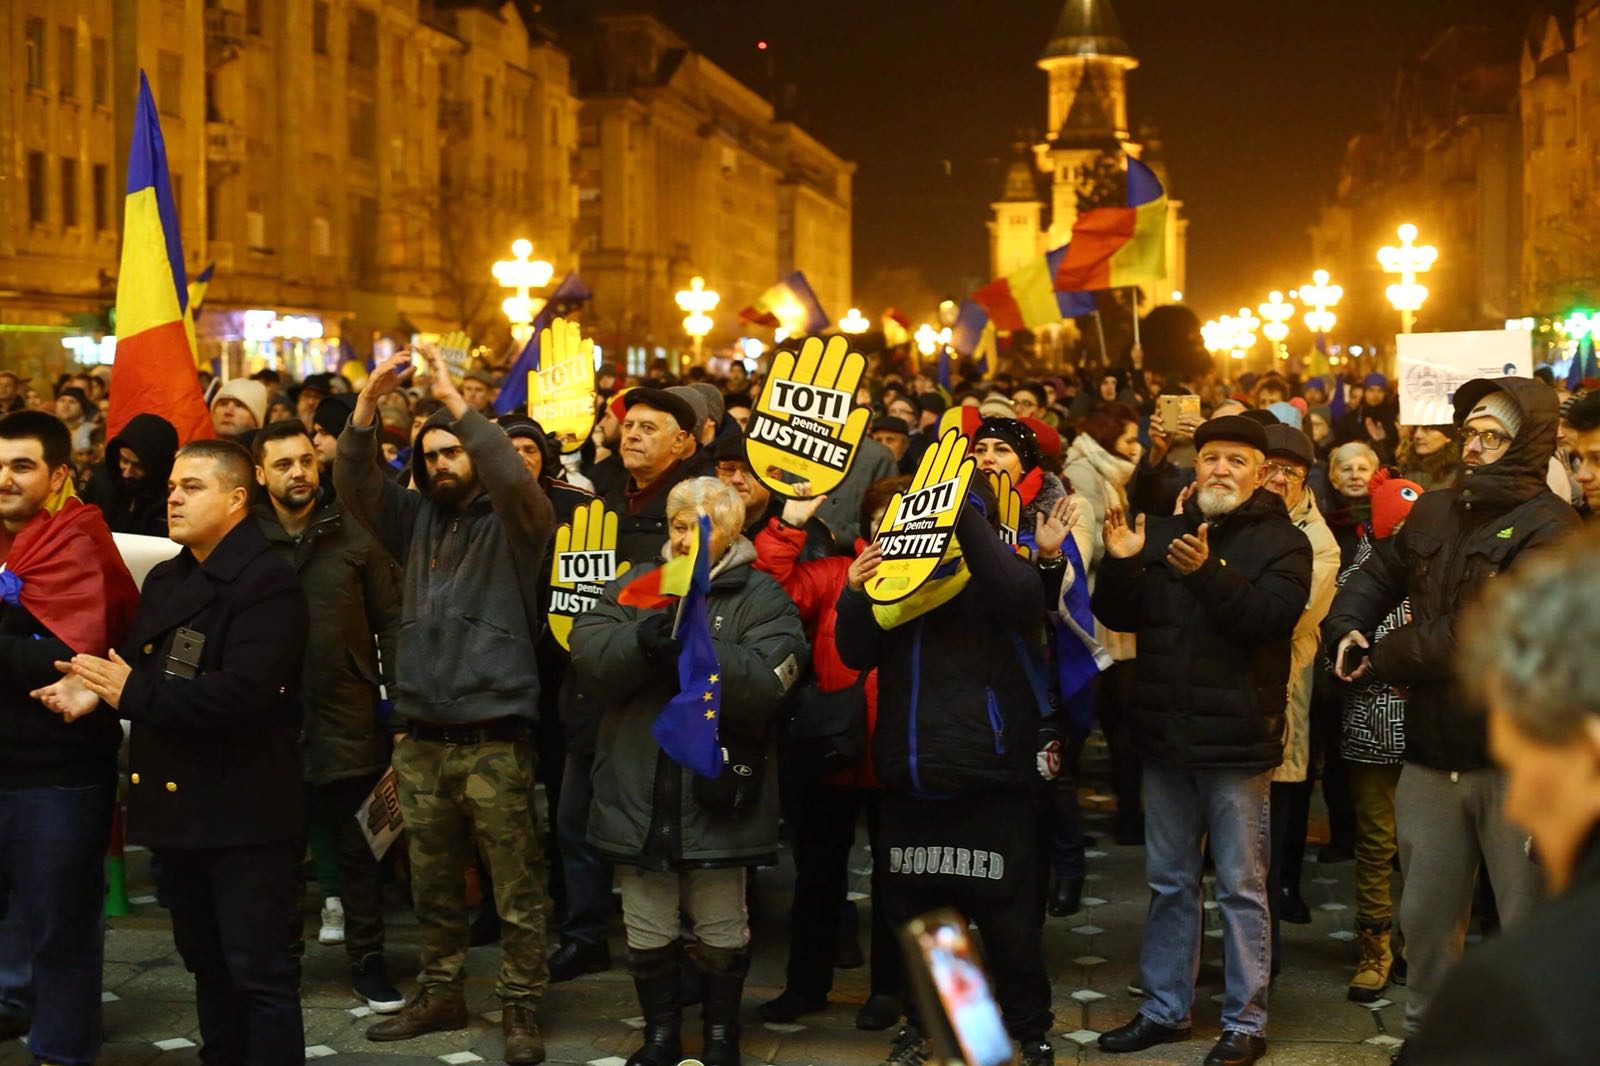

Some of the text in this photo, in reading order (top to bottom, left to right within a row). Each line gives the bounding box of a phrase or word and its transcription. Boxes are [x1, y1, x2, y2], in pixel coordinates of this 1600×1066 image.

[776, 382, 843, 419] TOȚI
[791, 416, 830, 436] pentru
[749, 416, 848, 468] JUSTIȚIE
[901, 482, 953, 520] TOȚI
[904, 520, 934, 533] pentru
[880, 533, 947, 557] USTIȚIE
[561, 554, 610, 580] TOȚI
[577, 584, 605, 595] pentr
